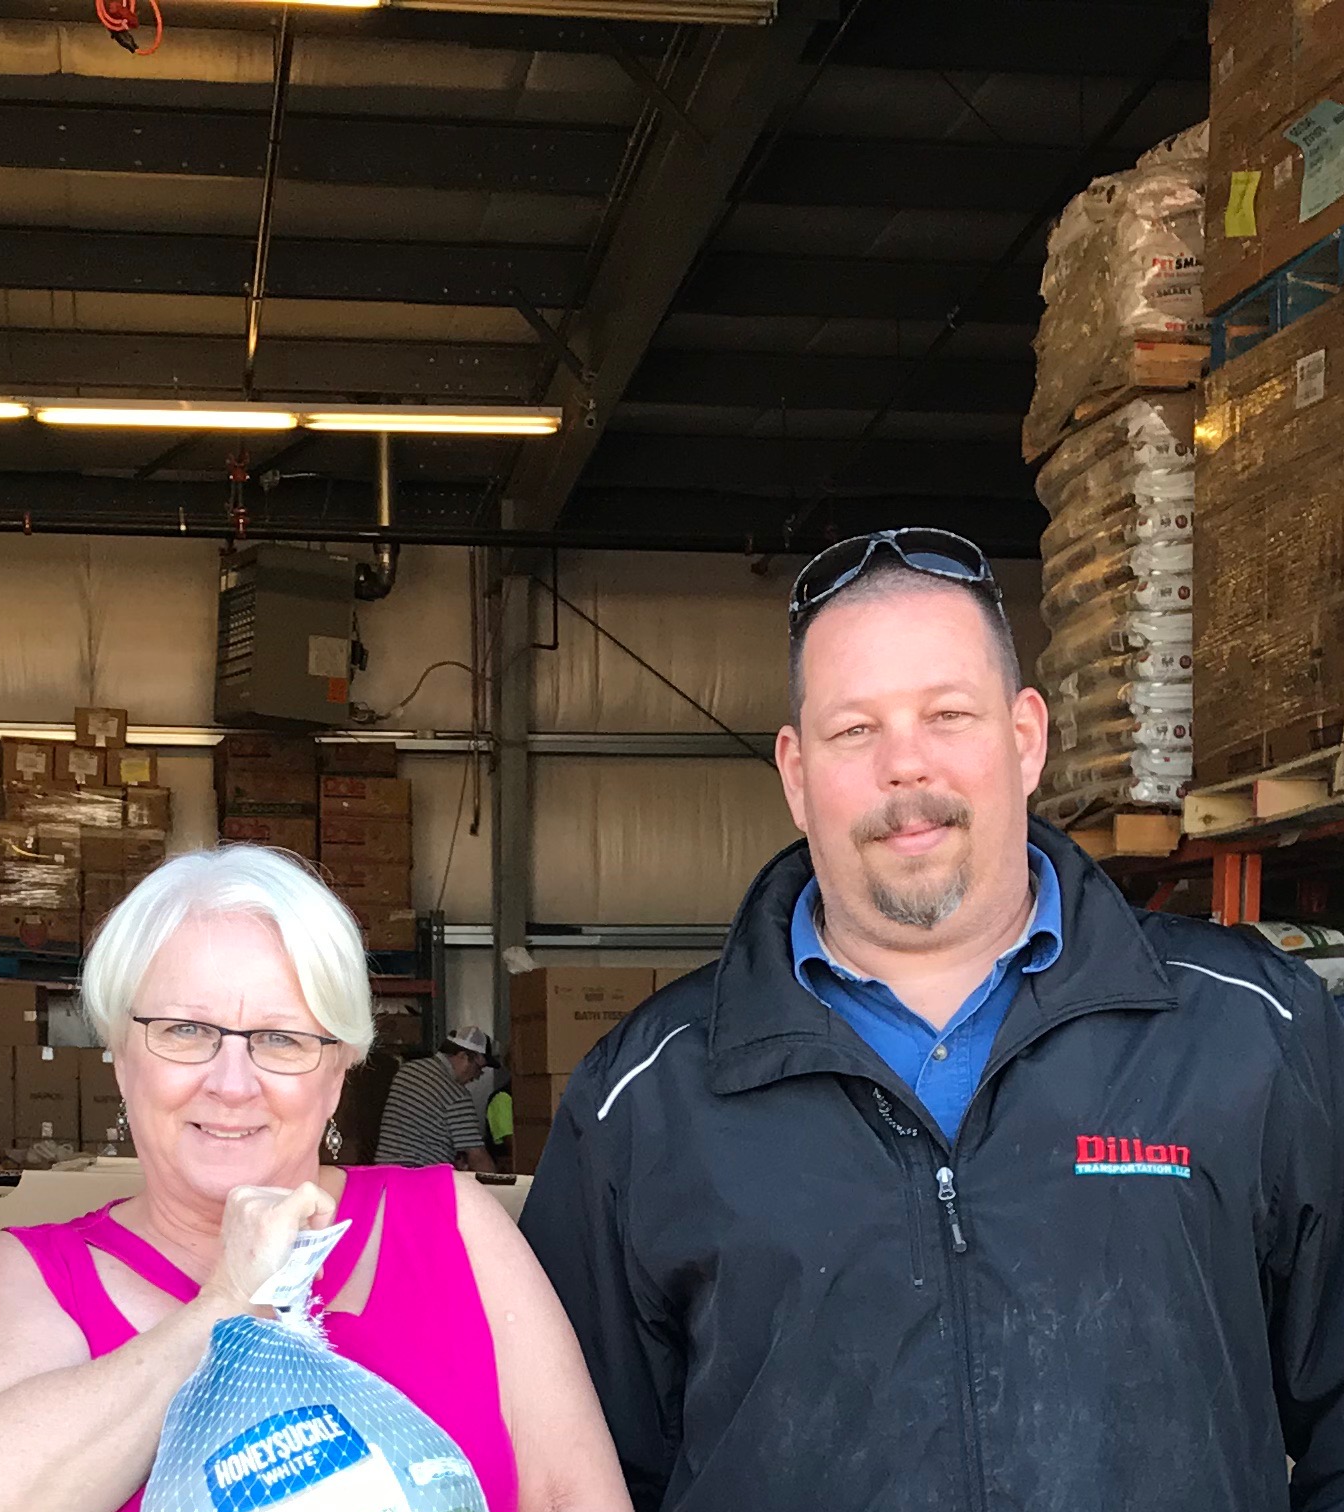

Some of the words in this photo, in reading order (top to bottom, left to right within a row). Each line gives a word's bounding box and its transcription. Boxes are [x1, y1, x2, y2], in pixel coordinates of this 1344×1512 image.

[1076, 1135, 1190, 1165] Dillon
[214, 1414, 345, 1489] HONEYSUCKLE
[261, 1450, 316, 1486] WHITE
